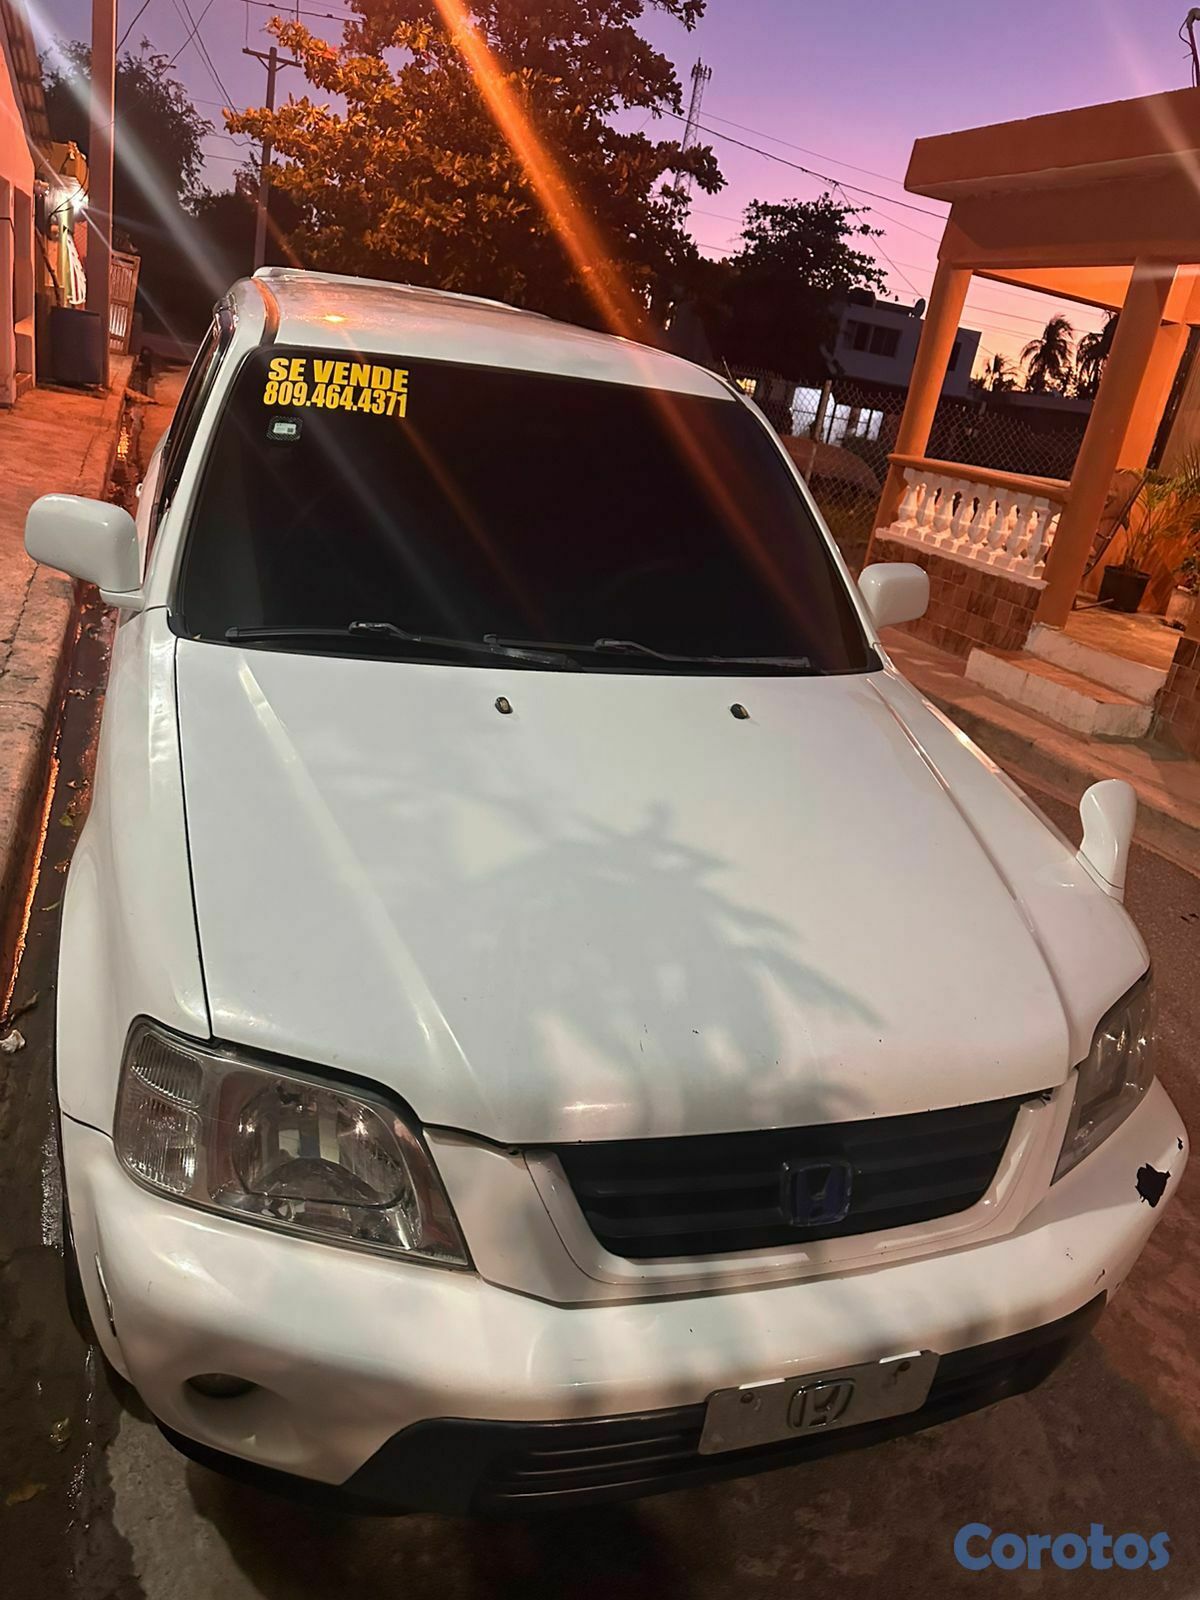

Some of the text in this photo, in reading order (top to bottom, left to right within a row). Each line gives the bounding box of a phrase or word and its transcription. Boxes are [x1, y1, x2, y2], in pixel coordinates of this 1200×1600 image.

[268, 358, 409, 393] SE VENDE
[263, 381, 408, 418] 809.464.4371
